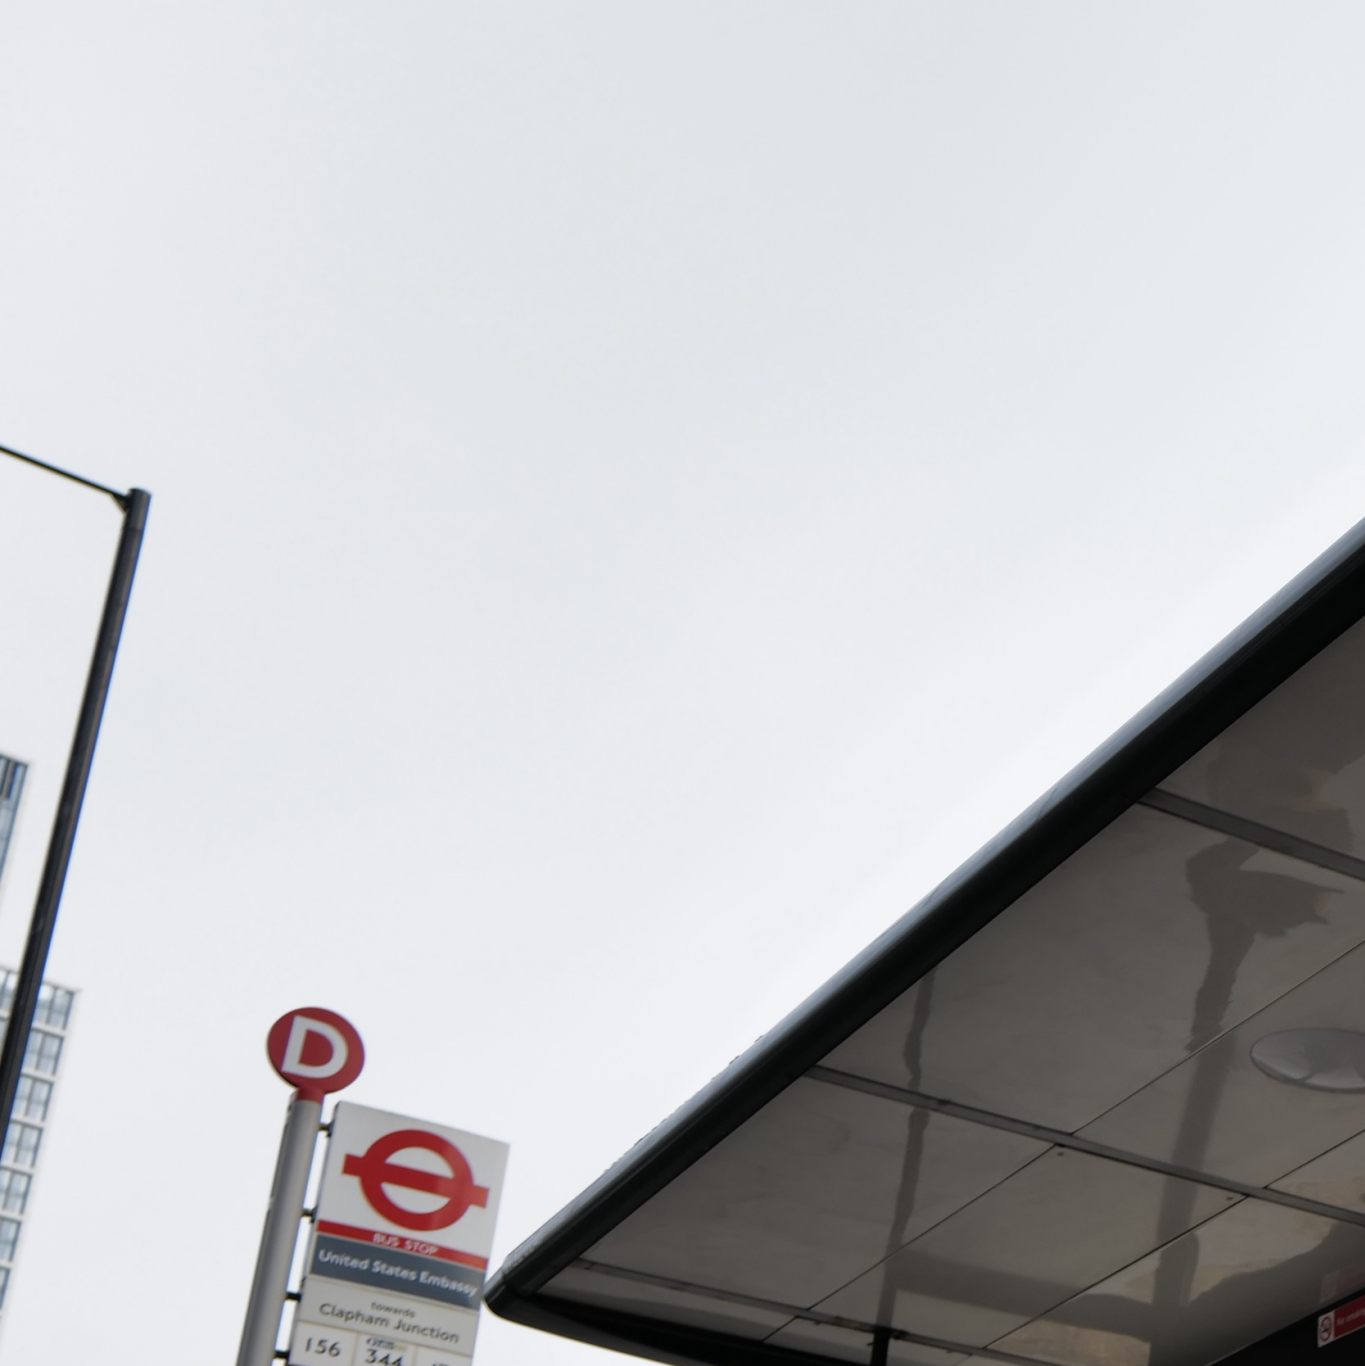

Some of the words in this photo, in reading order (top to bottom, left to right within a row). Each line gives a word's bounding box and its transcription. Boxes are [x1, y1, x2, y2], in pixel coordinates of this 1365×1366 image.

[282, 1015, 349, 1079] D
[372, 1232, 400, 1248] BUS
[404, 1239, 439, 1256] STOP
[318, 1249, 369, 1271] United
[371, 1259, 417, 1281] States
[418, 1271, 479, 1297] Embassy
[318, 1302, 390, 1328] Clapham
[393, 1319, 461, 1344] Junction
[370, 1301, 417, 1319] towards
[304, 1336, 341, 1358] 156
